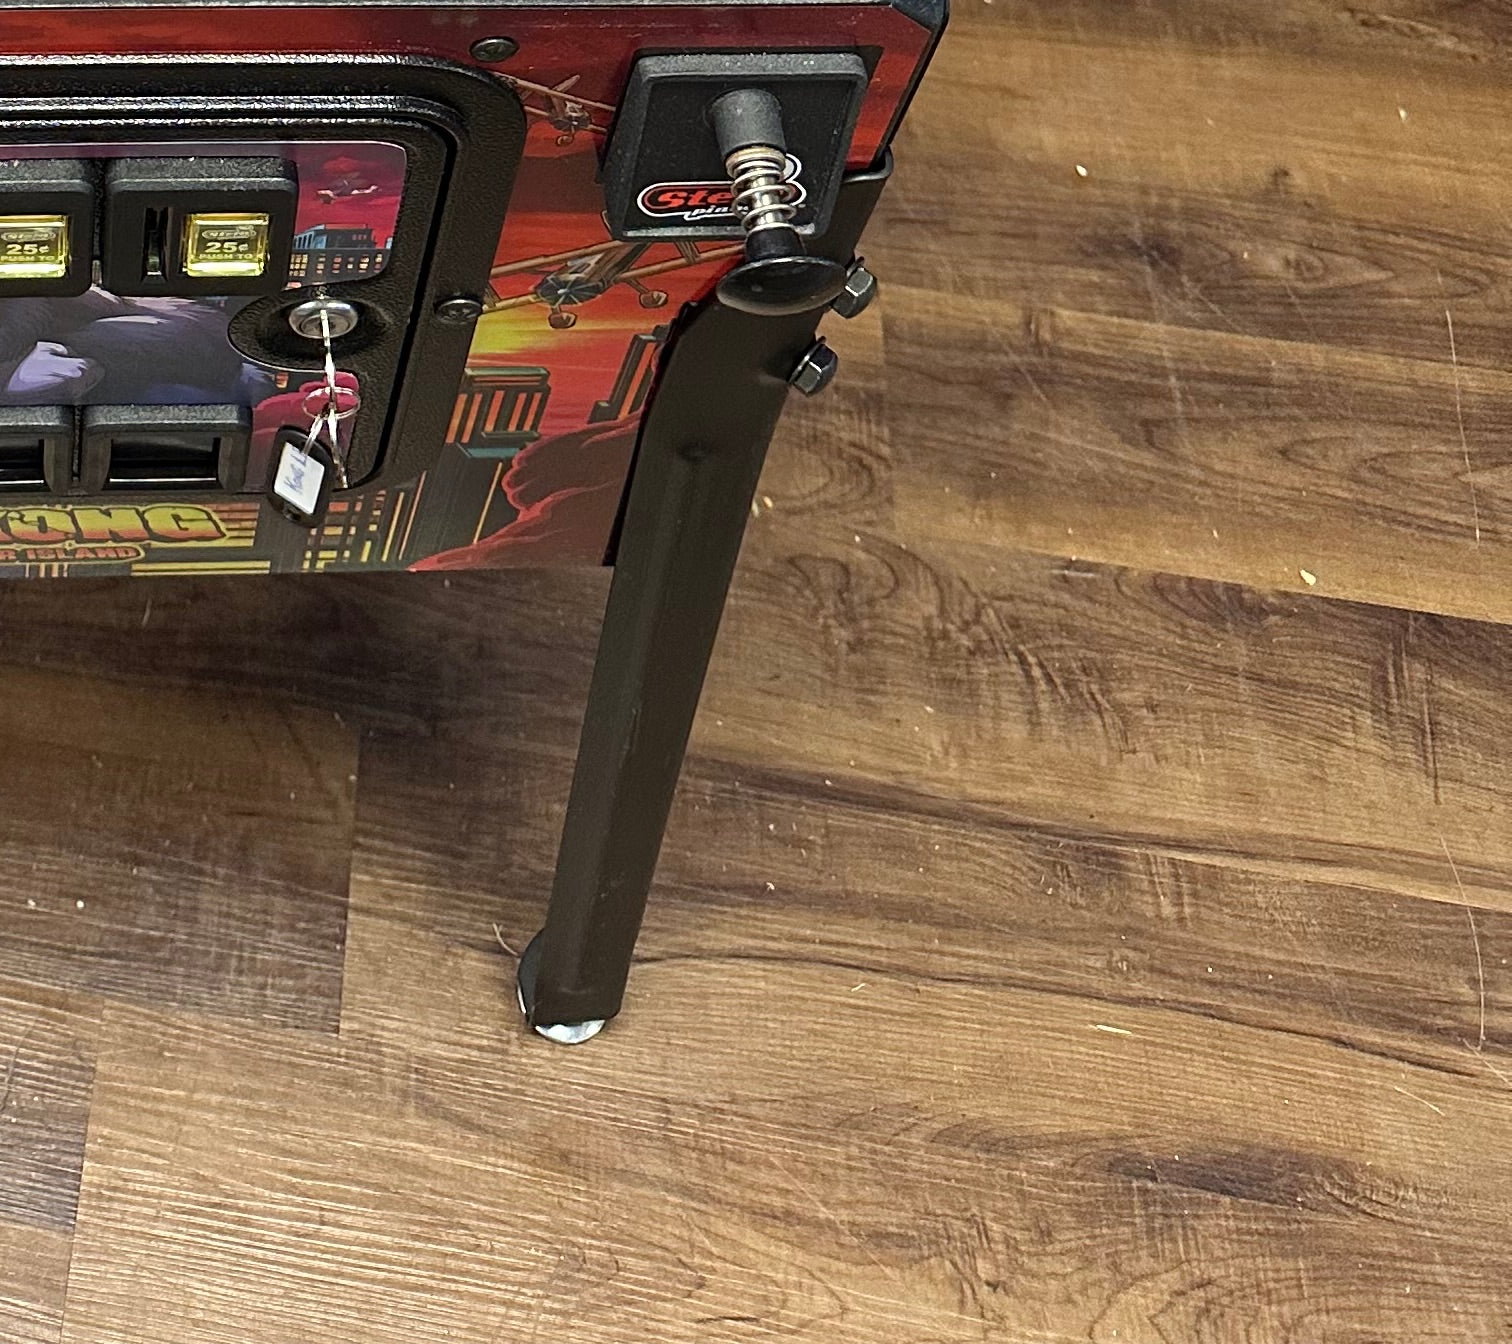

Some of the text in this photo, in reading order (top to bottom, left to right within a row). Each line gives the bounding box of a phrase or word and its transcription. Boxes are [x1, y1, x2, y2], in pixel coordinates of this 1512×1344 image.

[6, 244, 49, 255] 25¢
[205, 242, 249, 254] 25¢
[25, 546, 138, 560] ISLAND
